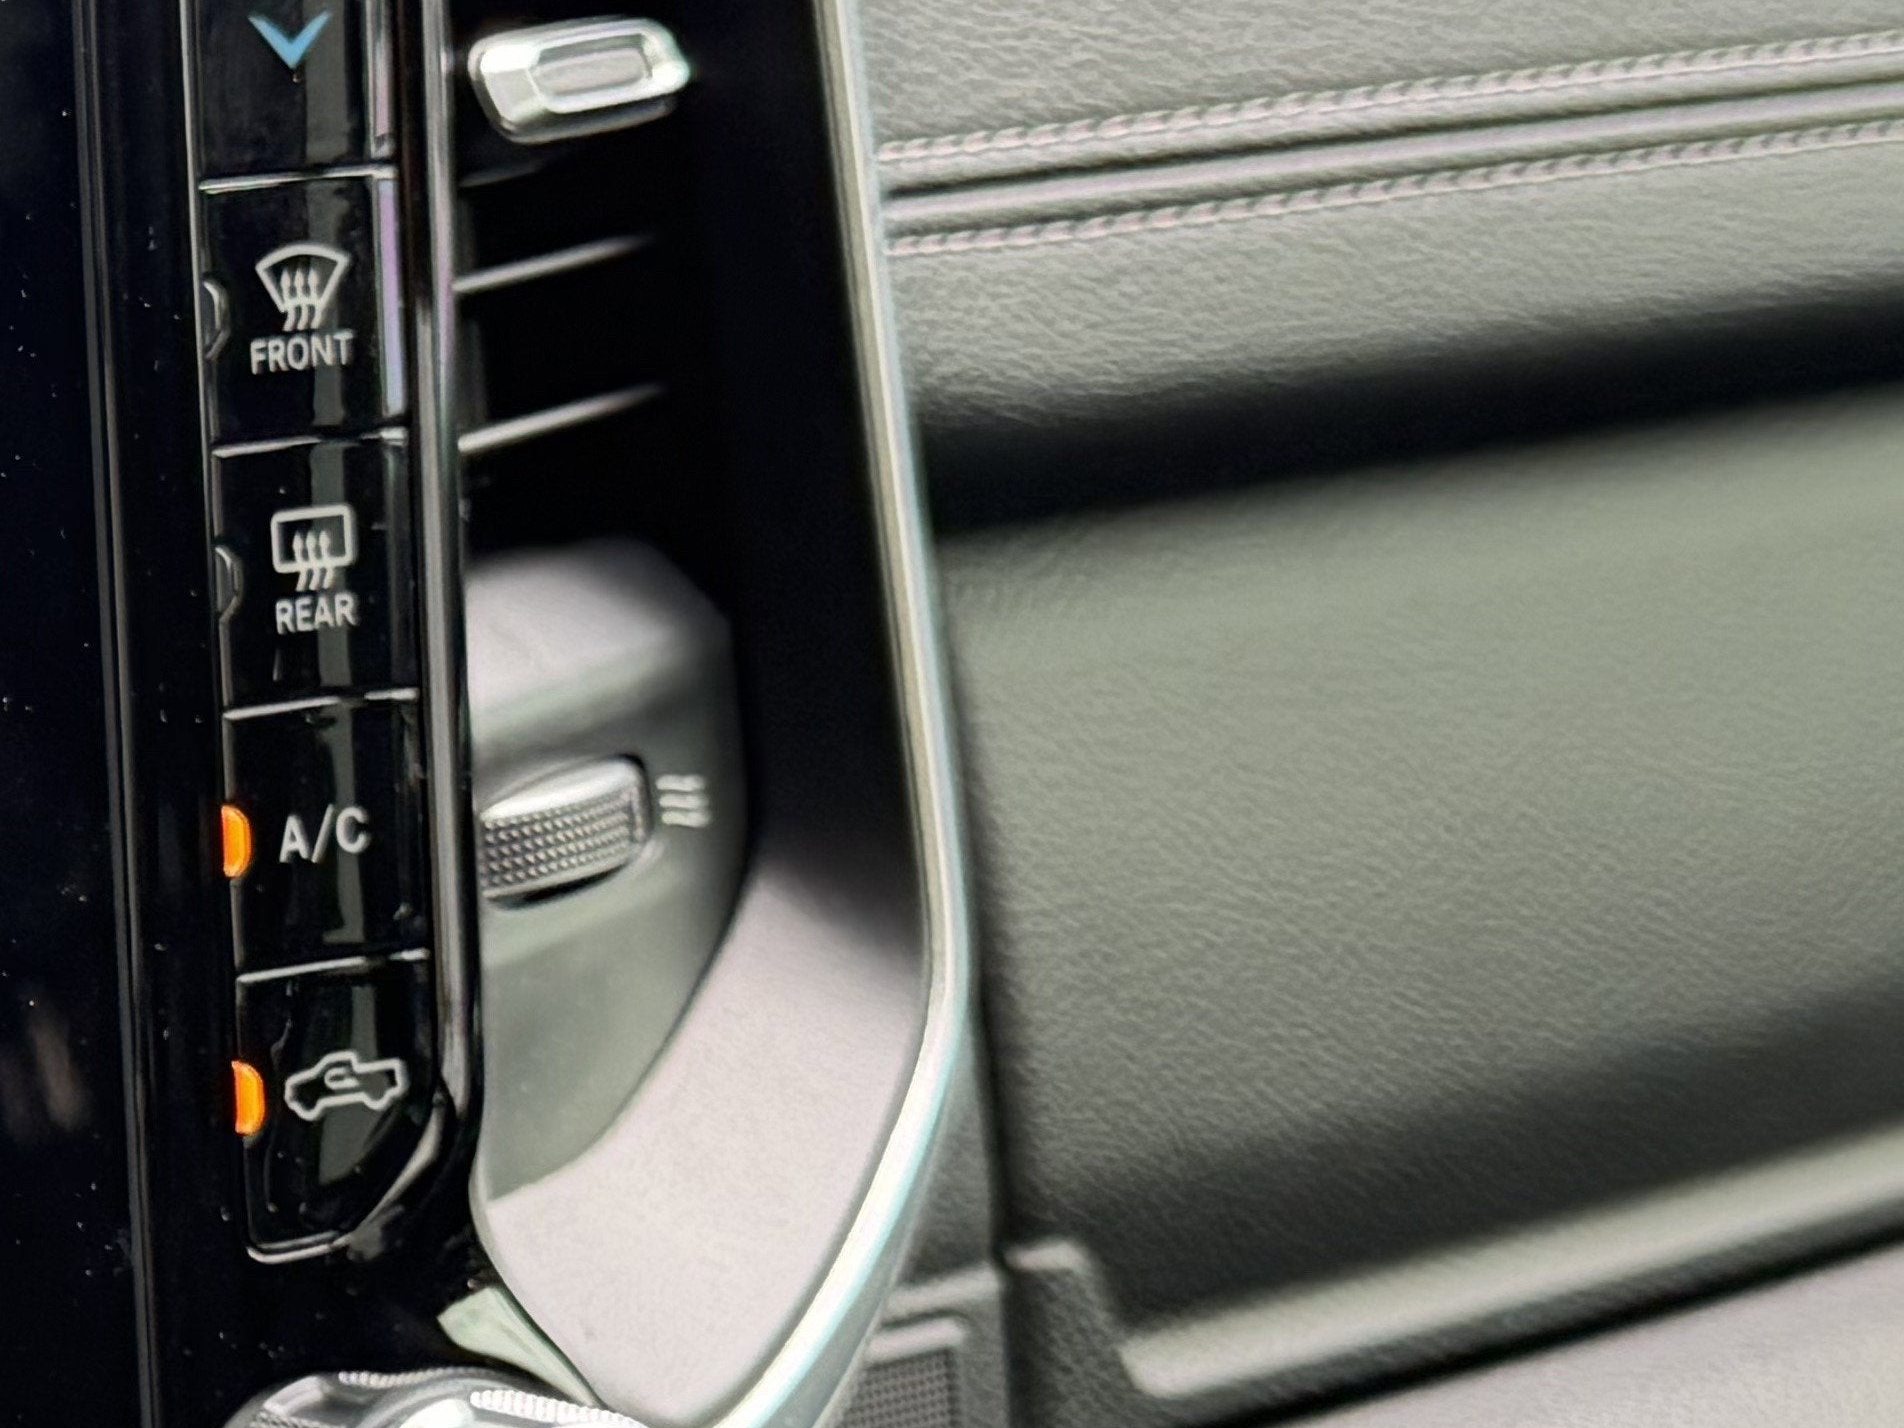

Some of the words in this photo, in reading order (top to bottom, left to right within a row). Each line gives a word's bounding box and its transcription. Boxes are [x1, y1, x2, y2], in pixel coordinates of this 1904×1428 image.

[249, 328, 354, 375] FRONT
[274, 590, 358, 635] REAR
[278, 802, 372, 864] A/C
